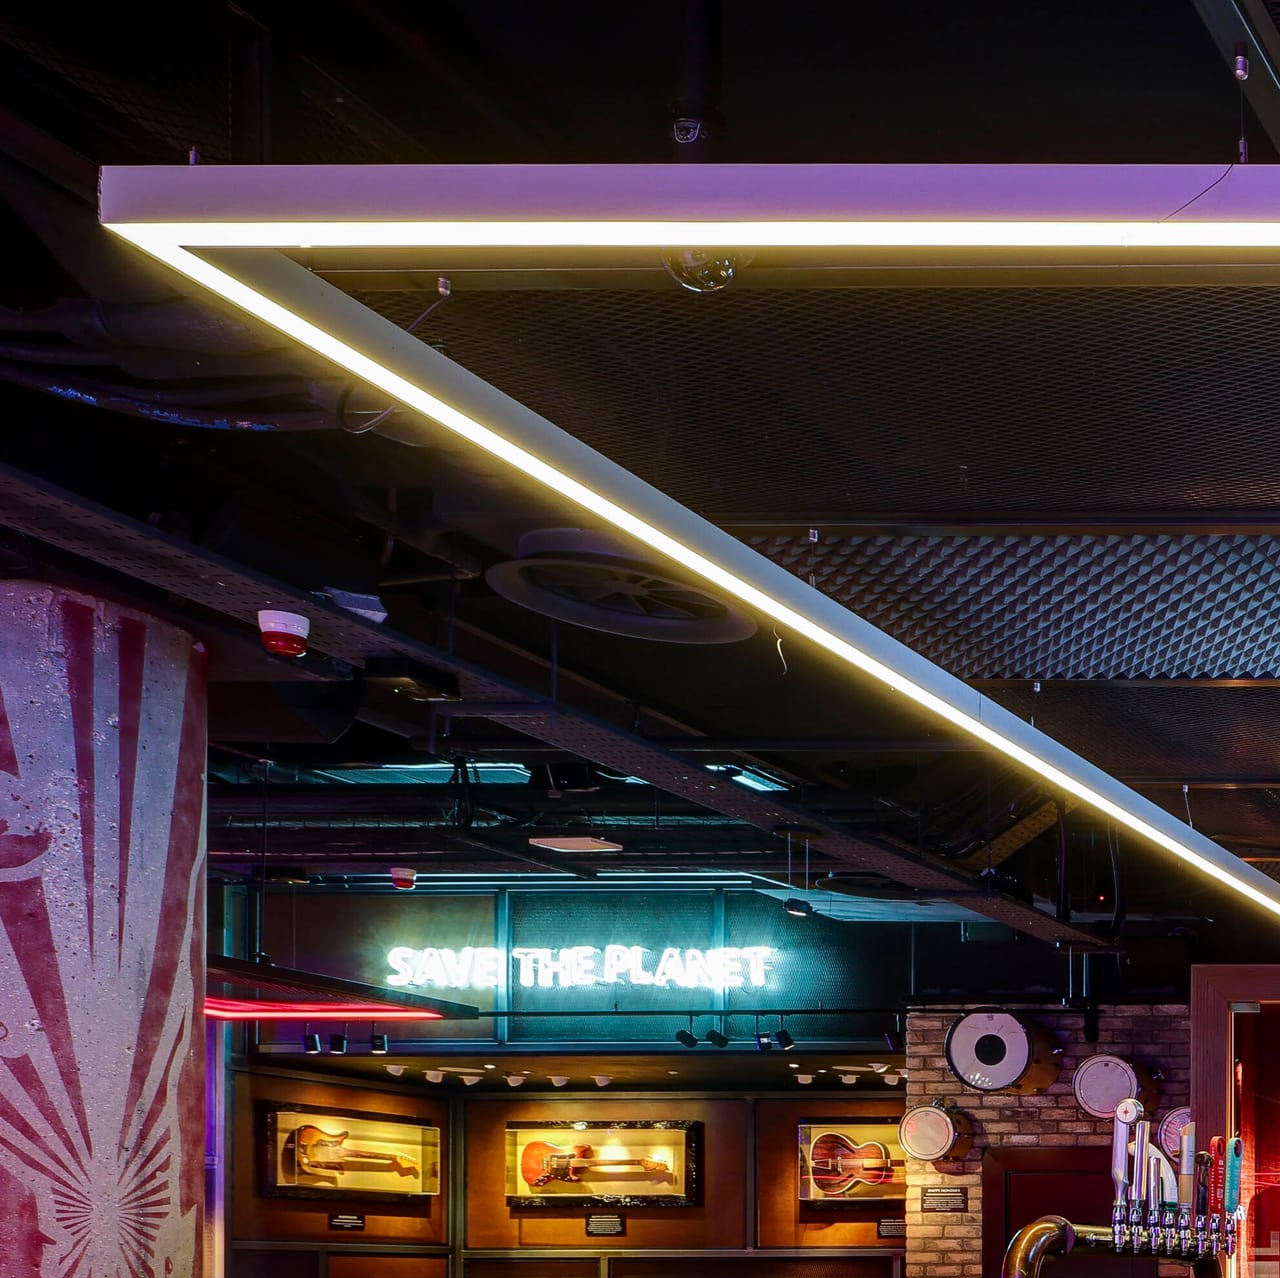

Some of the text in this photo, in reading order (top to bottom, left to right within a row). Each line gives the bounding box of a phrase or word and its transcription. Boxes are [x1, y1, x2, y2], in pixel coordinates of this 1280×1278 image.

[386, 944, 776, 988] SAVE THE PLANET
